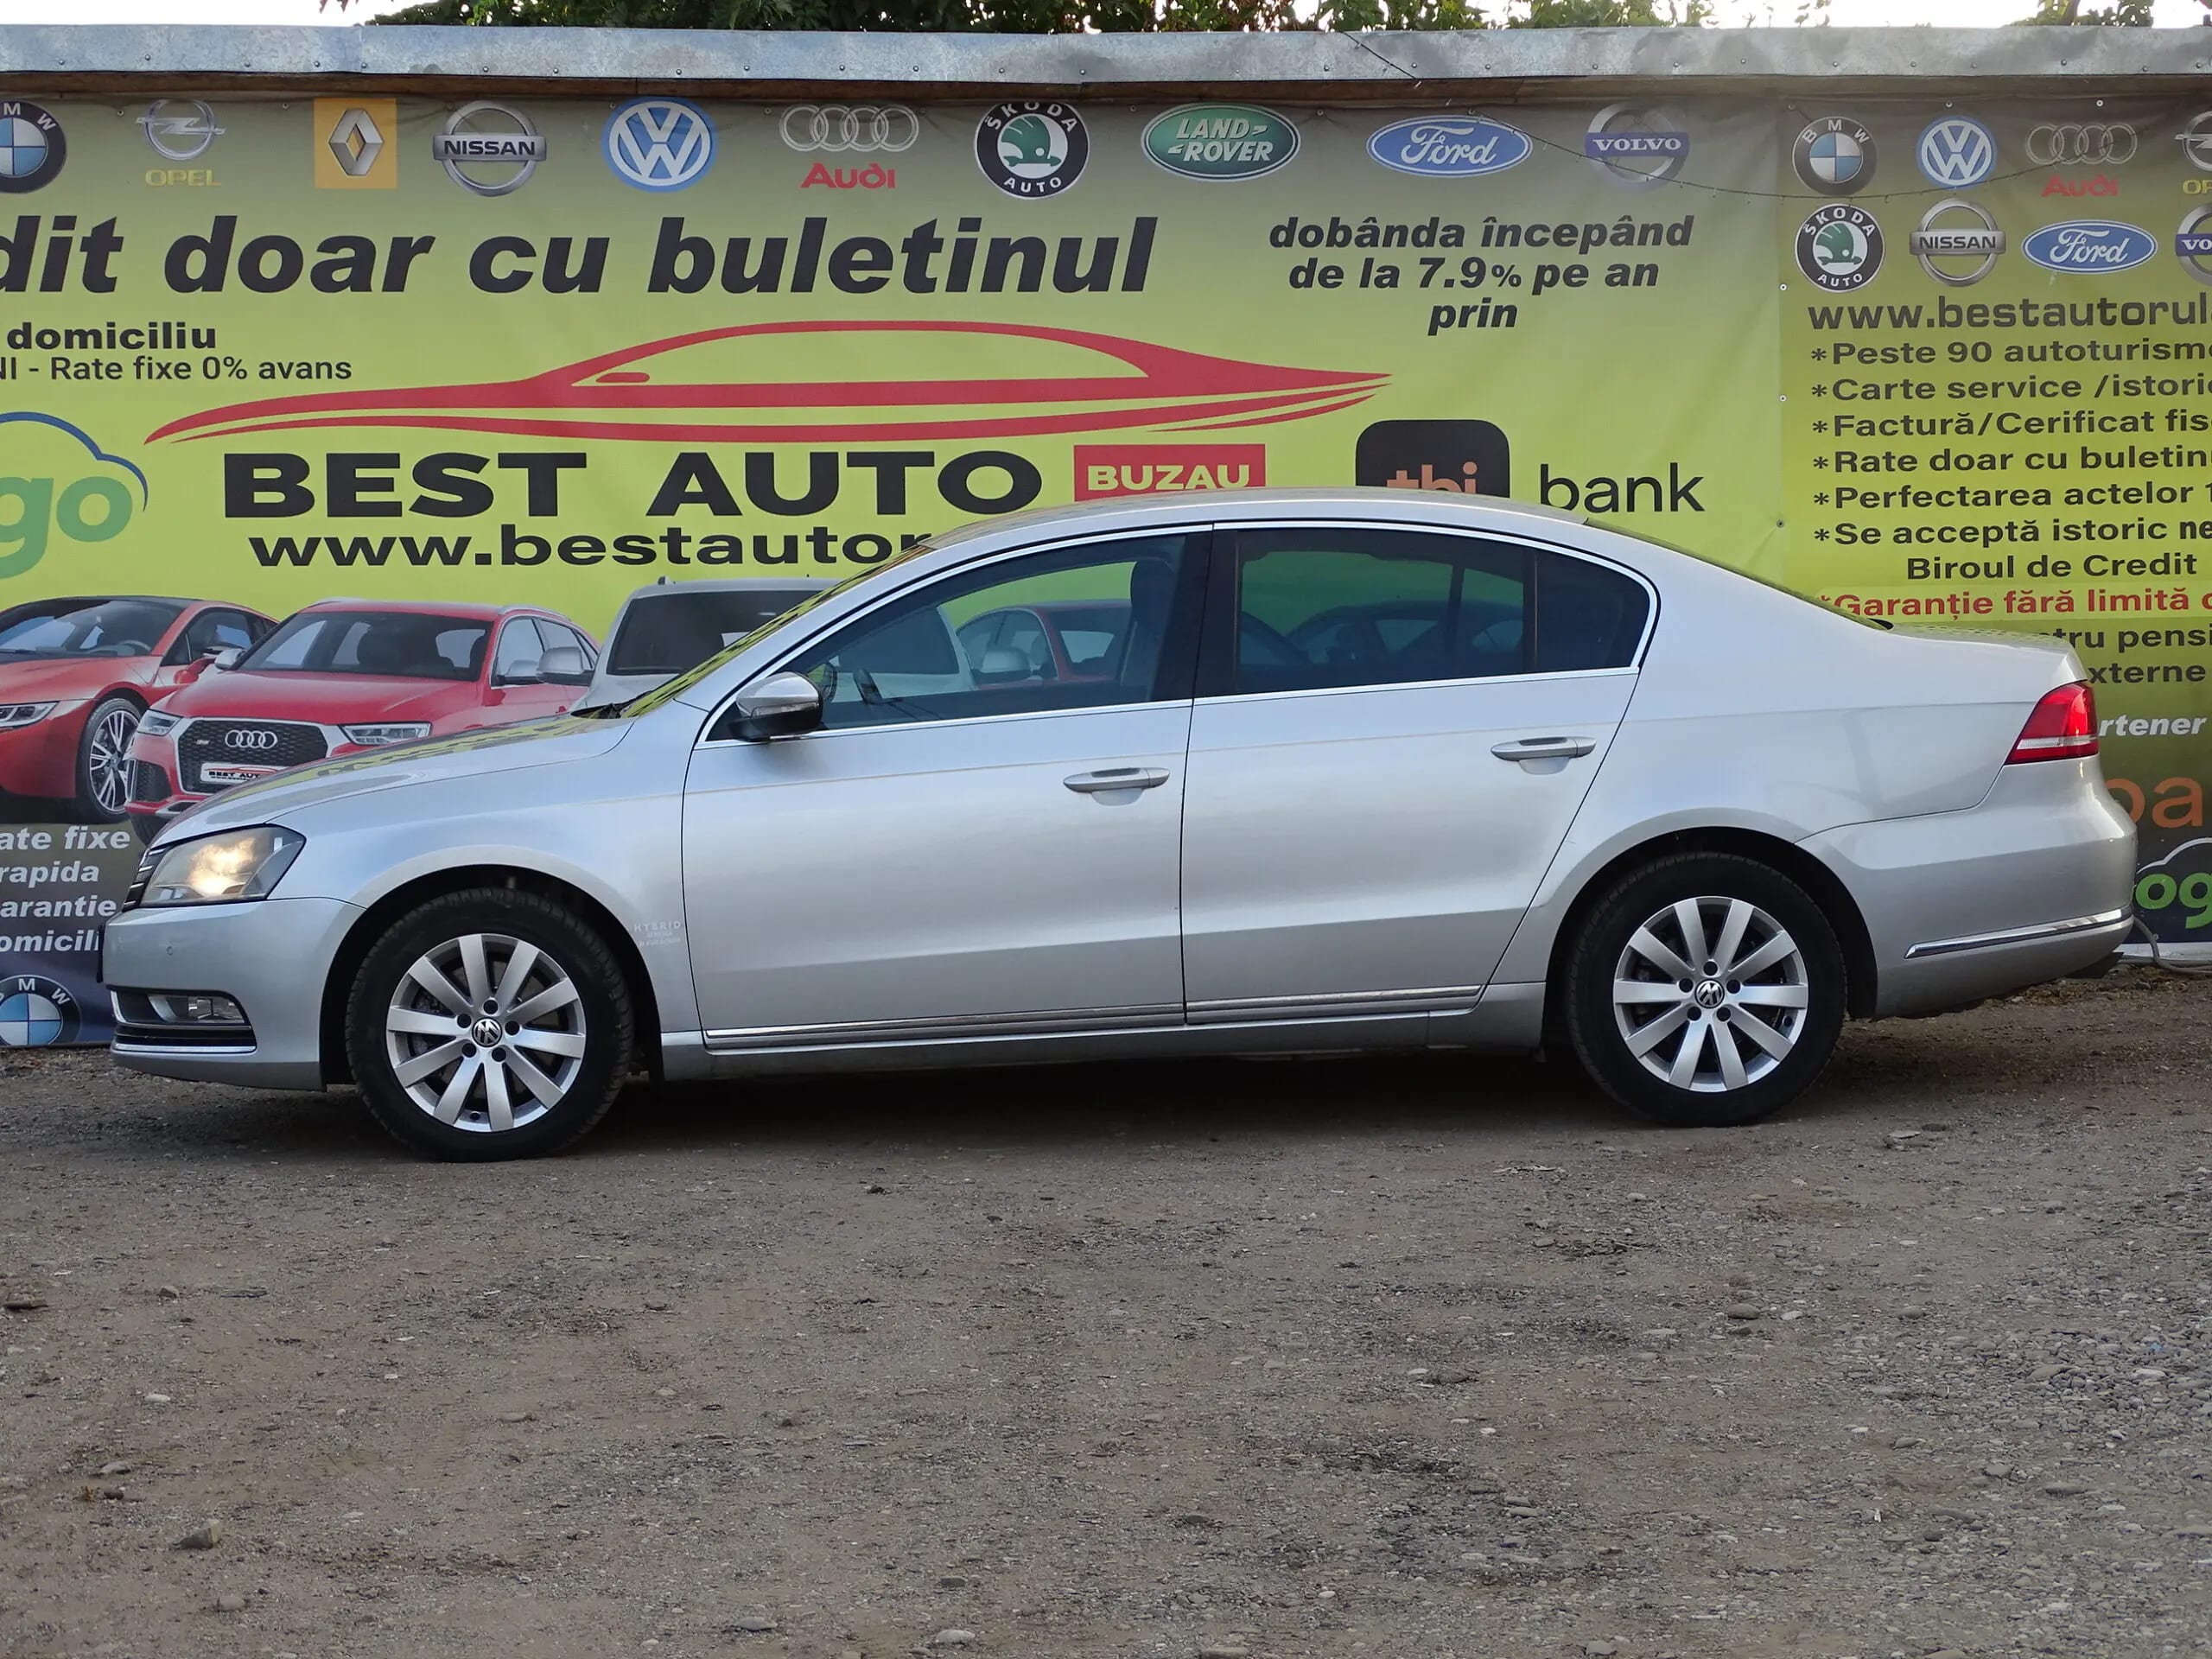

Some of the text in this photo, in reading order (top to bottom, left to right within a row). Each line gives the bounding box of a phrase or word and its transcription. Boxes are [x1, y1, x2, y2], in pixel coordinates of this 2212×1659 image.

[1175, 118, 1249, 140] LAND
[1803, 119, 1870, 145] BMW
[444, 139, 536, 156] NISSAN
[1184, 140, 1274, 164] ROVER
[1402, 122, 1497, 168] Ford
[1592, 136, 1682, 151] VOLVO
[145, 169, 221, 187] OPEL
[800, 162, 895, 189] Audi
[1004, 177, 1062, 193] AUTO
[2041, 173, 2119, 198] Audi
[1269, 214, 1695, 255] dobânda începând
[1919, 235, 1996, 250] NISSAN
[2050, 226, 2129, 265] Ford
[163, 215, 436, 294] doar
[468, 235, 610, 294] cu
[647, 215, 1158, 294] buletinul
[1288, 257, 1659, 296] de la 7.9% pe an
[1818, 272, 1863, 288] AUTO
[1427, 296, 1518, 336] prin
[1808, 292, 2212, 330] www.bestautorul
[7, 321, 217, 350] domiciliu
[1948, 341, 1993, 363] 90
[2004, 336, 2212, 362] autoturism
[51, 357, 124, 380] Rate
[133, 355, 192, 380] fixe
[201, 356, 248, 380] 0%
[258, 359, 353, 380] avans
[1947, 374, 2082, 399] service
[2094, 372, 2212, 398] /istori
[2165, 408, 2212, 432] fis
[1929, 448, 2014, 471] doar
[2024, 451, 2068, 470] cu
[2080, 445, 2212, 469] buletin
[223, 450, 1043, 518] BEST AUTO
[1087, 464, 1250, 491] BUZAU
[1540, 462, 1706, 512] bank
[2063, 480, 2195, 506] actelor
[1893, 518, 2040, 548] acceptă
[2052, 517, 2168, 543] istoric
[1907, 552, 2198, 580] Biroul de Credit
[2004, 589, 2075, 614] fără
[2088, 588, 2187, 613] limită
[64, 824, 131, 849] fixe
